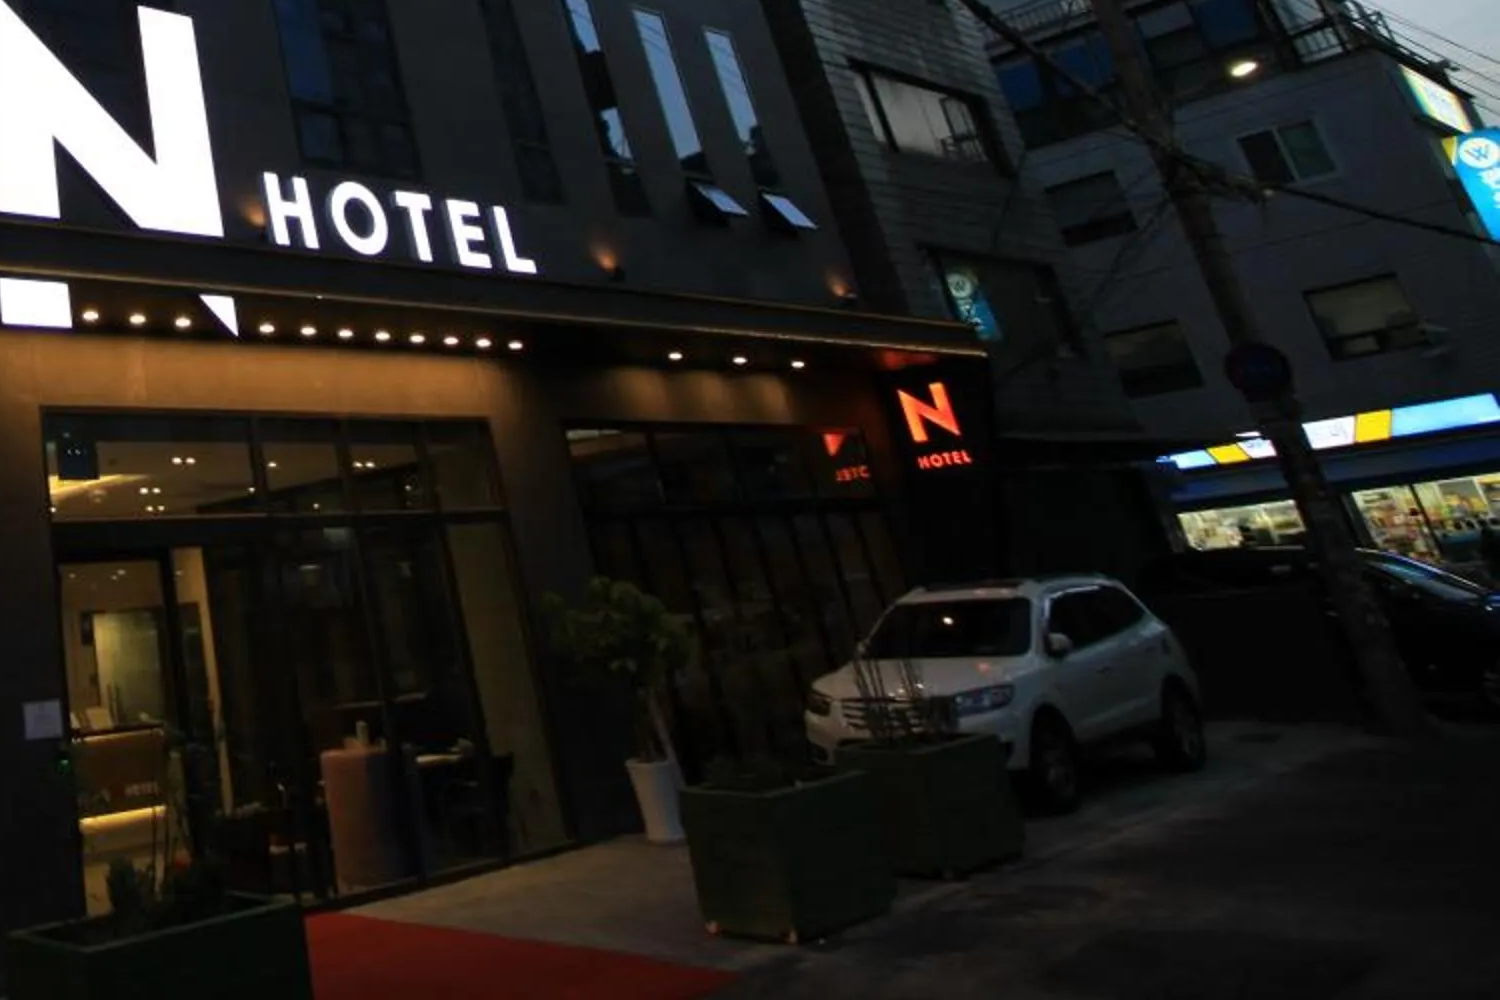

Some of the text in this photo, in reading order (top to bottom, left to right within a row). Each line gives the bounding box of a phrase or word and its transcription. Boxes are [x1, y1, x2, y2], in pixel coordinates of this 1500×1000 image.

[263, 171, 537, 274] HOTEL
[897, 382, 962, 442] N
[917, 450, 973, 470] HOTEL
